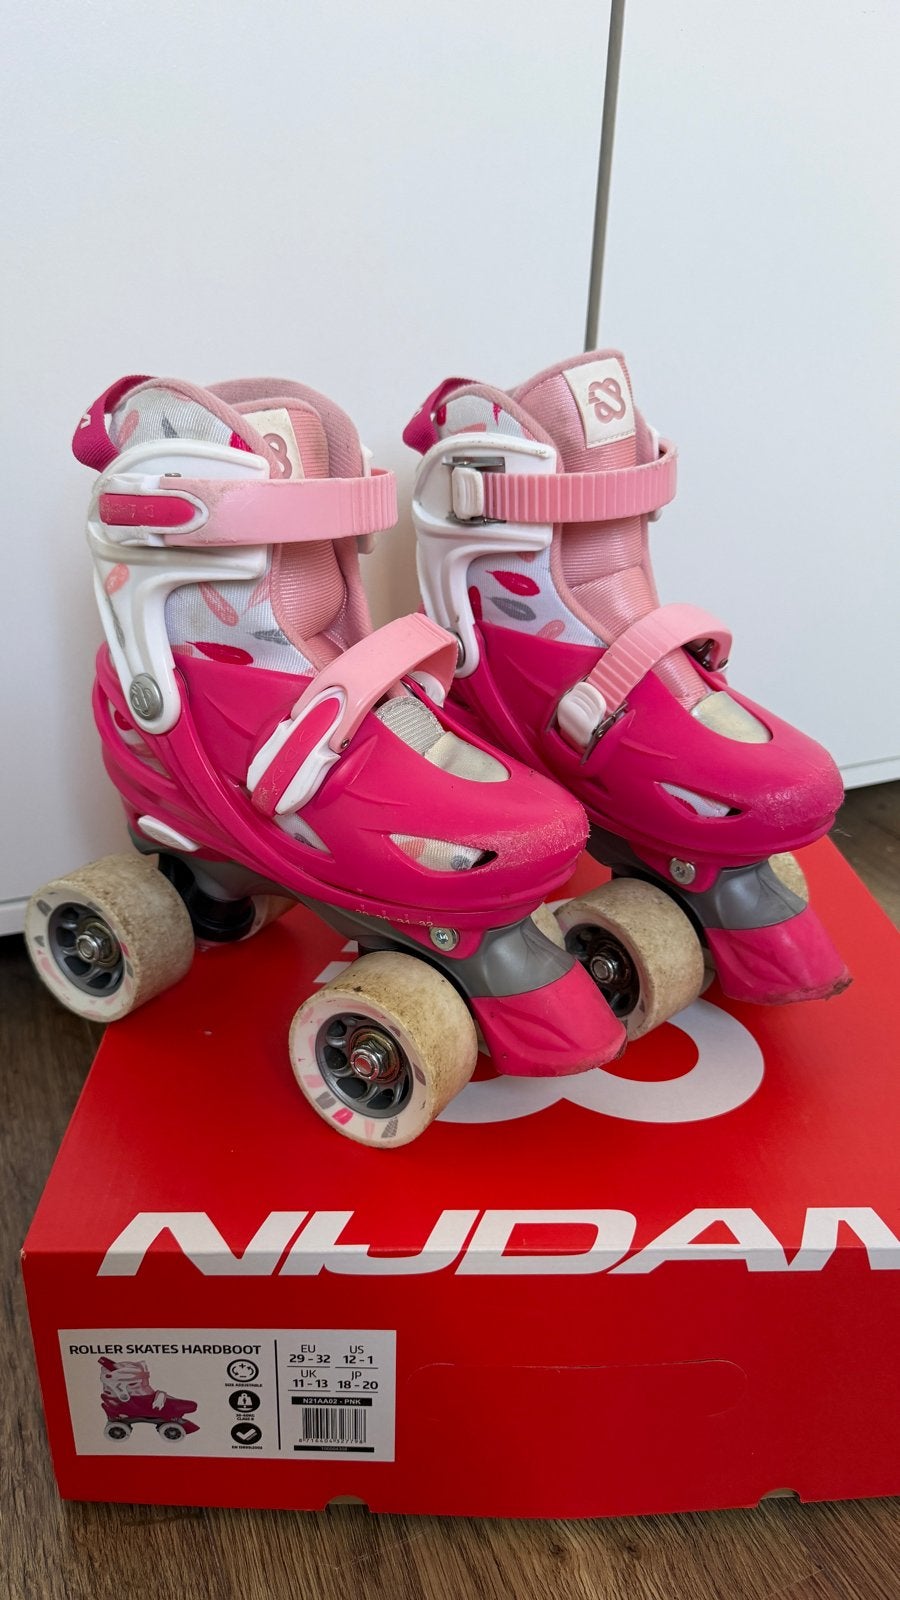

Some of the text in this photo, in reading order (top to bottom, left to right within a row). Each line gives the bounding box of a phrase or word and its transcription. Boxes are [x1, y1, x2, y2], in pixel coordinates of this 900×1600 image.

[69, 1344, 262, 1354] ROLLER SKATES HARDBOOT
[301, 1344, 316, 1353] EU
[350, 1346, 364, 1354] US
[289, 1354, 305, 1362] 29
[316, 1354, 330, 1363] 32
[343, 1355, 356, 1364] 12
[367, 1356, 373, 1364] 1
[301, 1370, 317, 1378] UK
[351, 1371, 362, 1380] JP
[293, 1379, 304, 1387] 11
[316, 1380, 328, 1388] 13
[338, 1381, 351, 1389] 18
[362, 1381, 378, 1390] 20
